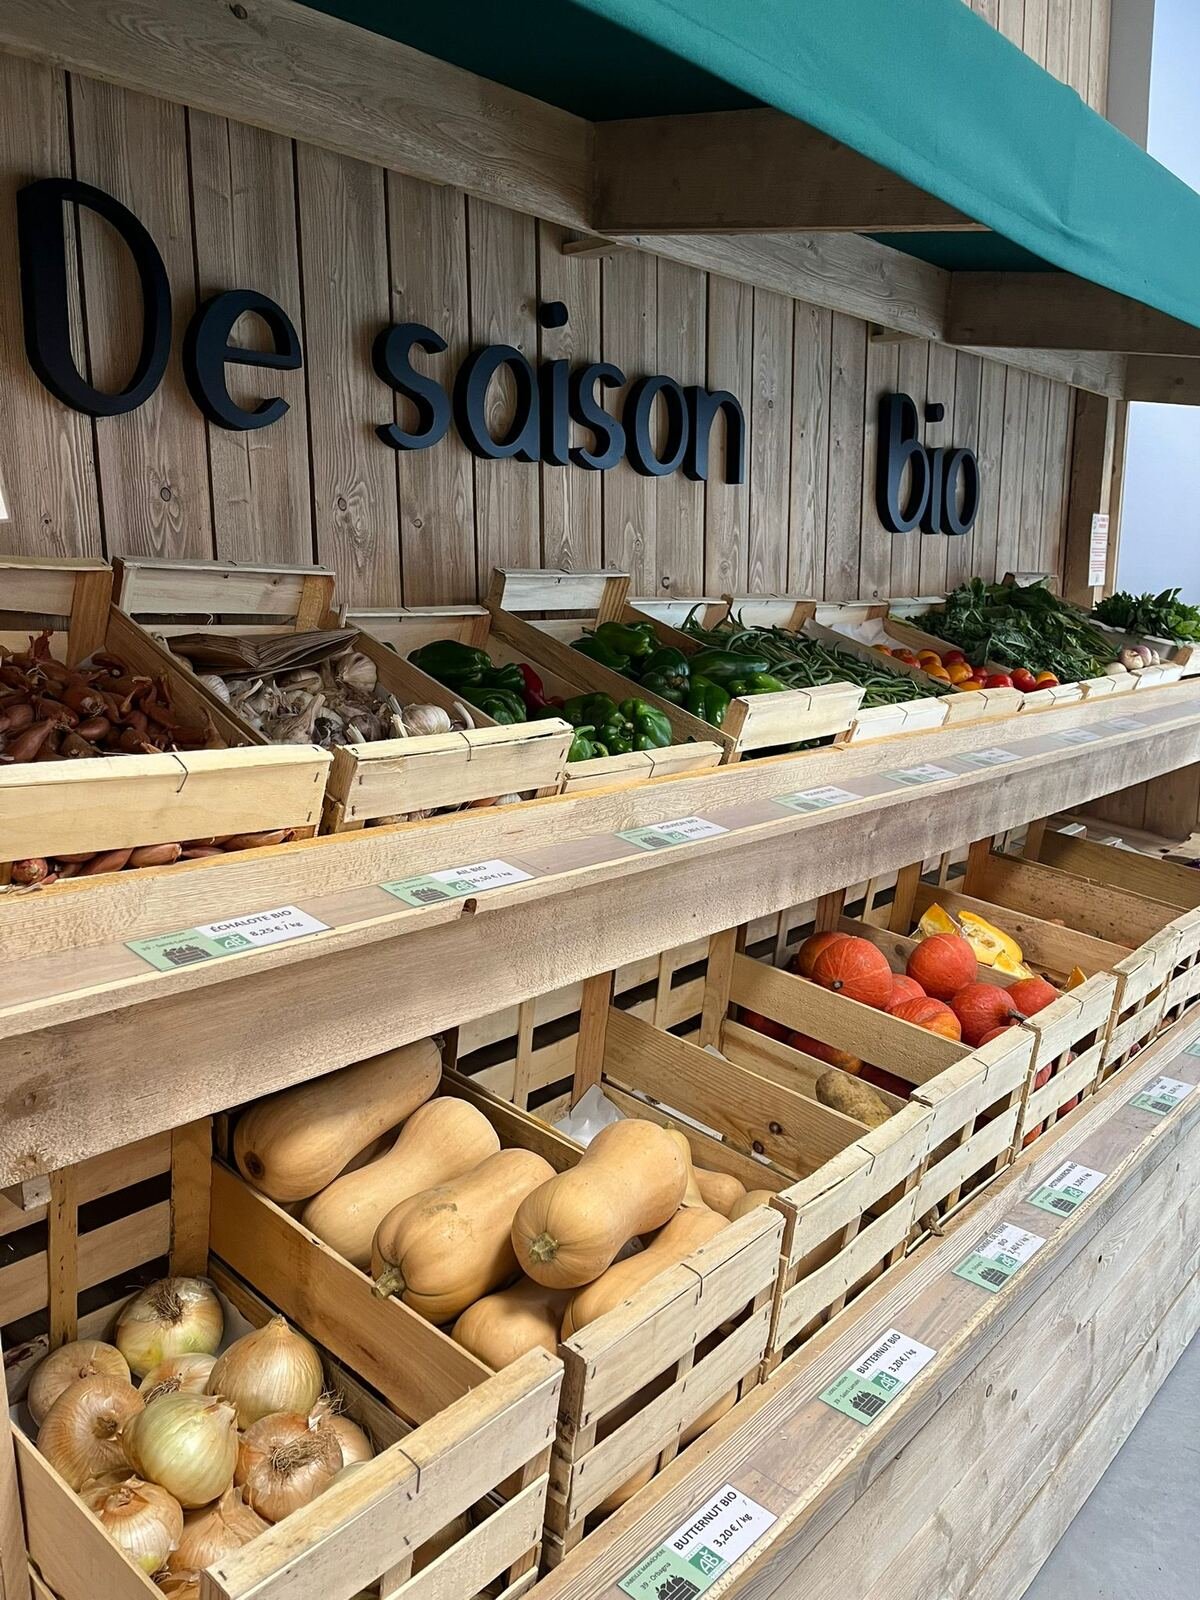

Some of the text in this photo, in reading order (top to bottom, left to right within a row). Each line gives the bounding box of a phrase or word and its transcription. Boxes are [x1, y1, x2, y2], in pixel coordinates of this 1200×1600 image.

[17, 177, 981, 536] De saison bio
[210, 910, 292, 934] ÉCHALOTE BIO
[857, 1333, 901, 1374] BUTTERNUT BIO
[888, 1359, 904, 1372] 3,20
[673, 1491, 737, 1550] BUTTERNUT BIO
[713, 1529, 733, 1548] 3,20
[741, 1513, 753, 1523] kg
